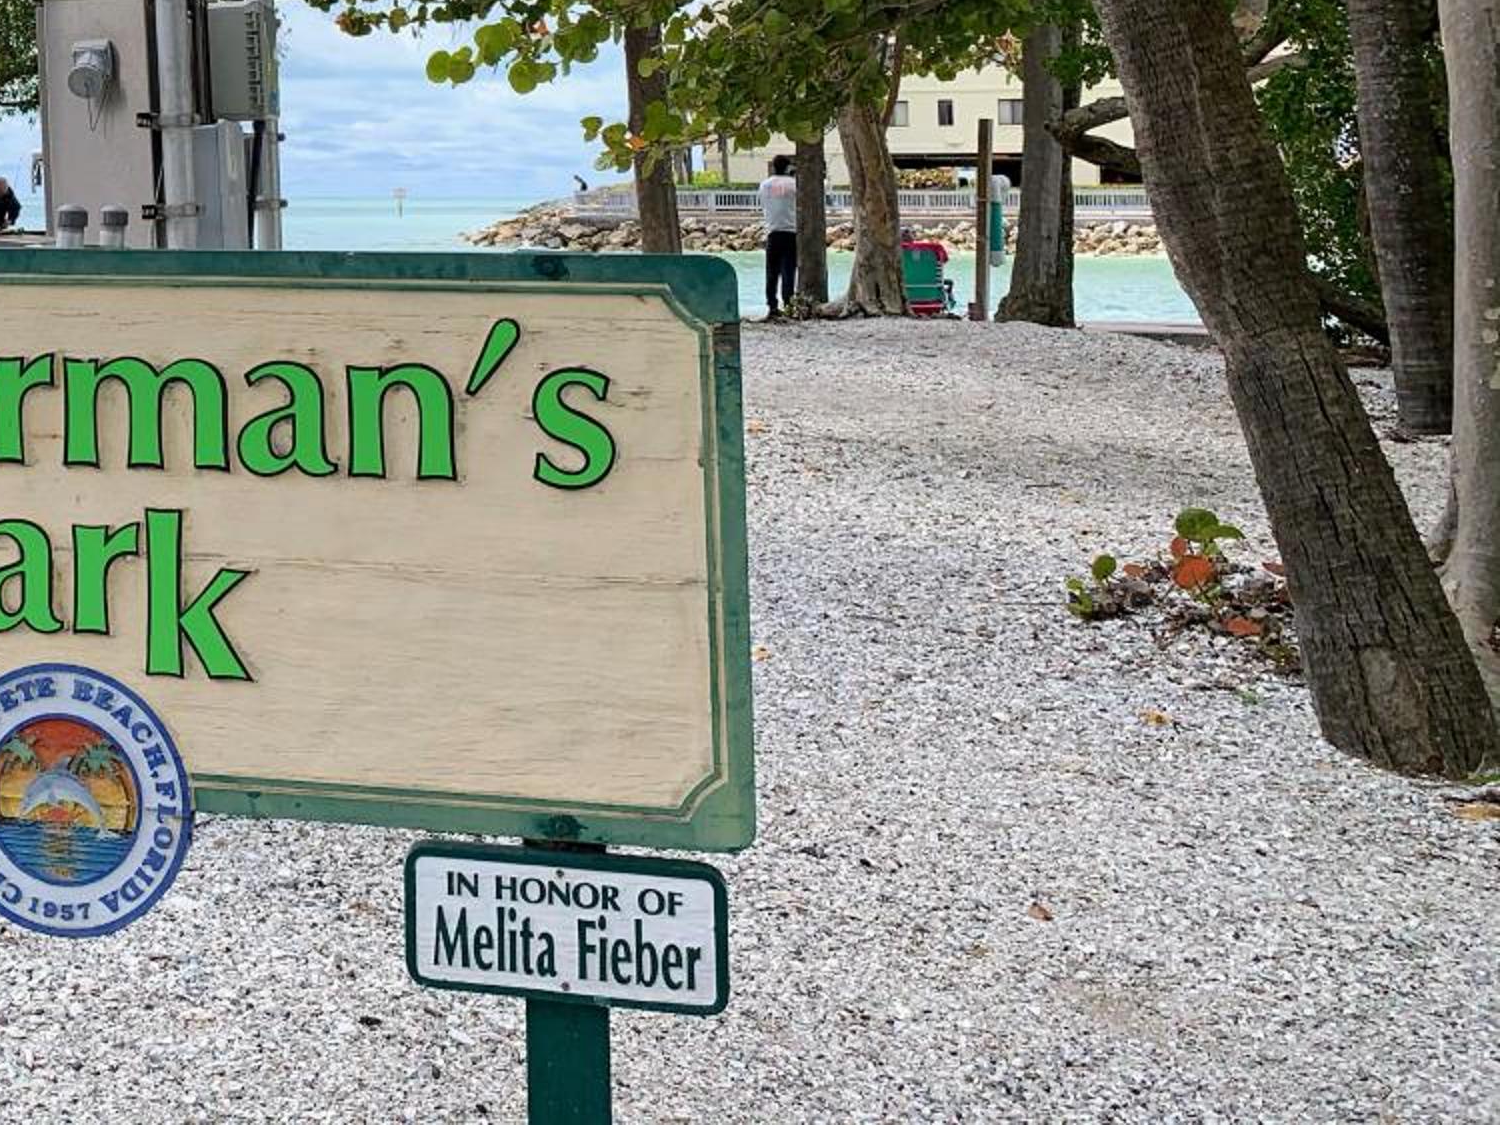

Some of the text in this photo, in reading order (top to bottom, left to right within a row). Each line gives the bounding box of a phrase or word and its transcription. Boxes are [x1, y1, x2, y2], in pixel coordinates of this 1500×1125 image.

[97, 779, 178, 915] FLORIDA
[27, 895, 92, 922] 1957
[446, 870, 684, 917] IN HONOR OF
[432, 904, 703, 992] Melita Fieber
